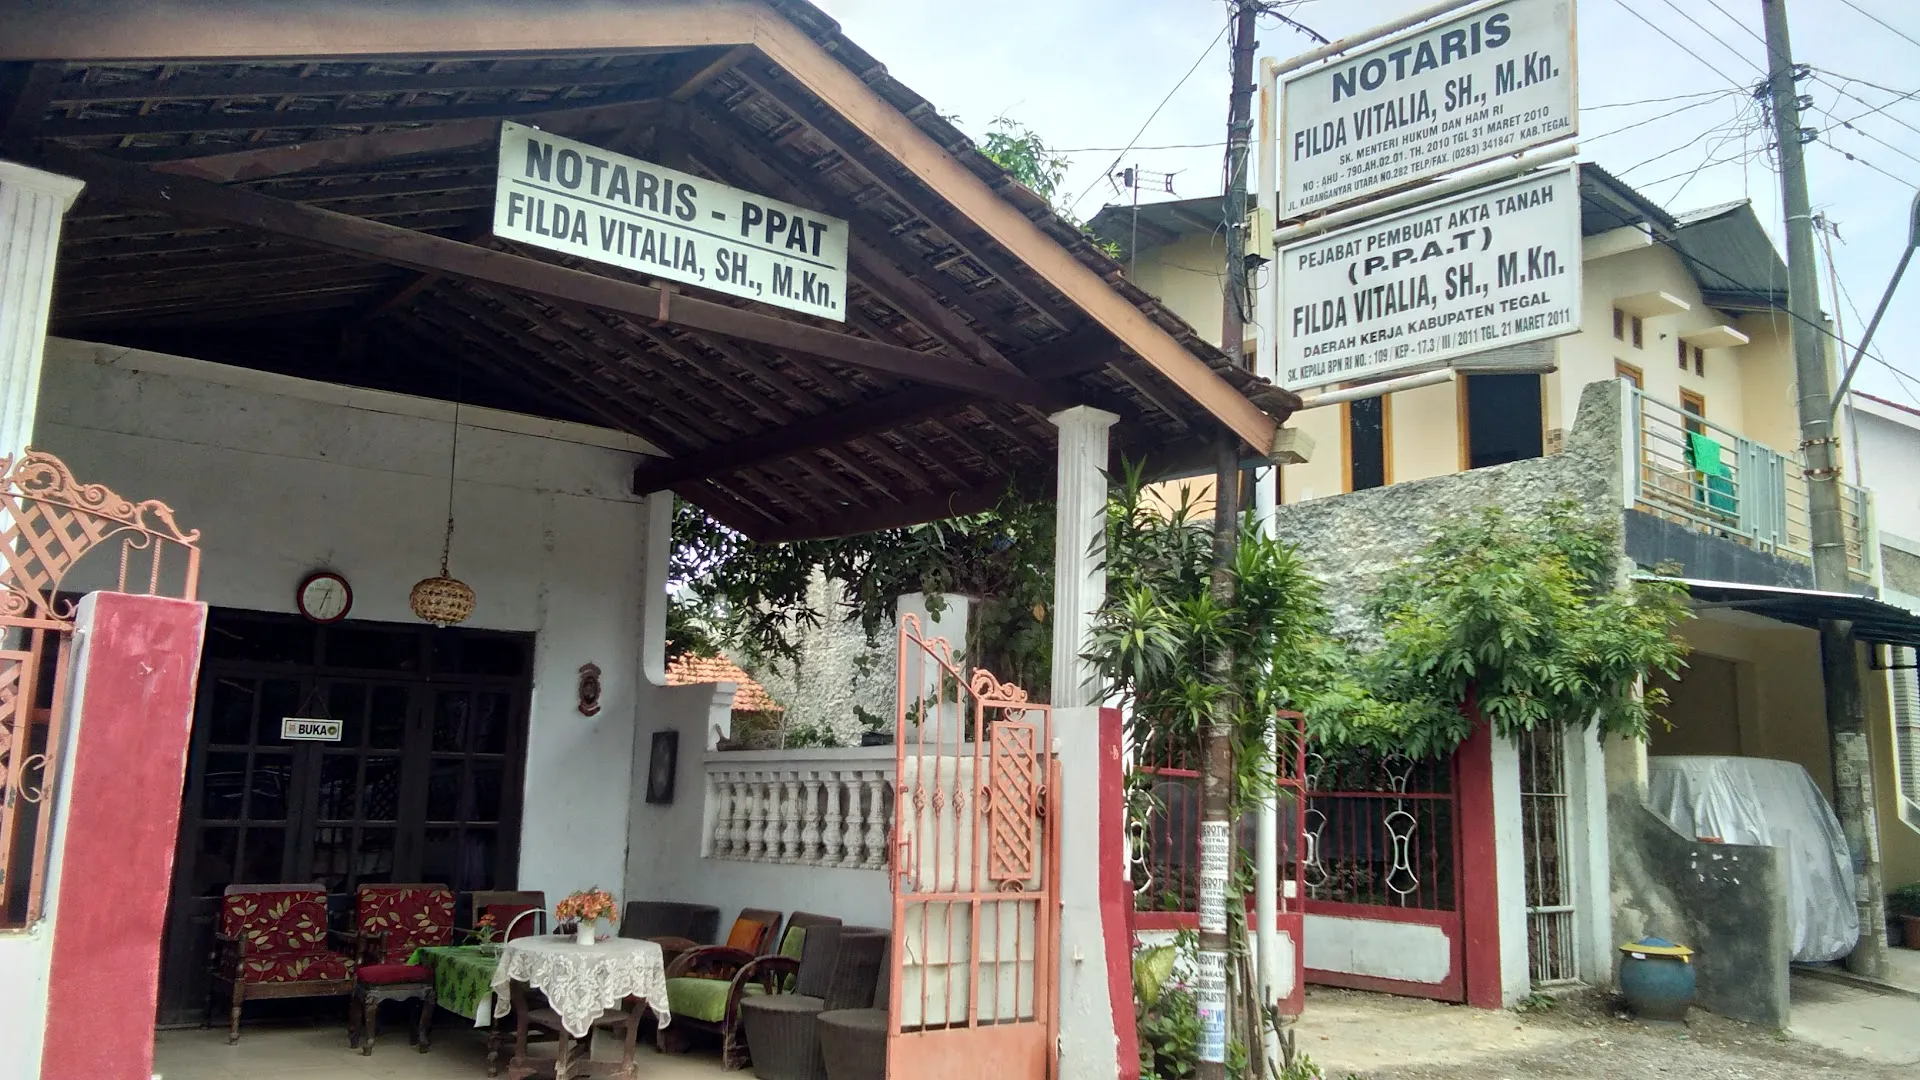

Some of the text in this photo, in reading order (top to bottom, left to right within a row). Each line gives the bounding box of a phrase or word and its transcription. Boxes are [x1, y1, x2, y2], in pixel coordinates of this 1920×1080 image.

[1332, 12, 1511, 103] NOTARIS
[1294, 51, 1559, 162] FILDA VITALIA, SH., M.Kn.
[1322, 172, 1338, 187] AHU
[1410, 146, 1424, 158] TH.
[1427, 136, 1449, 150] 2010
[1453, 132, 1468, 144] TGL
[1472, 127, 1482, 138] 31
[1487, 116, 1520, 134] MARET
[1524, 106, 1549, 122] 2010
[1340, 104, 1503, 165] SK. MENTERI HUKUM DAN HAM RI
[525, 139, 697, 222] NOTARIS
[741, 201, 827, 257] PPAT
[1288, 201, 1297, 211] JL.
[1300, 183, 1352, 207] KARANGANYAR
[1354, 175, 1378, 190] UTARA
[1411, 155, 1449, 173] TELP/FAX.
[1452, 146, 1480, 162] (0283)
[1482, 133, 1514, 150] 341847
[1520, 126, 1540, 140] KAB.
[1543, 117, 1570, 133] TEGAL
[507, 192, 836, 309] FILDA VITALIA, SH., M.Kn.
[1299, 184, 1553, 271] PEJABAT PEMBUAT AKTA TANAH
[1293, 245, 1564, 338] FILDA VITALIA, SH., M.Kn.
[1304, 292, 1550, 358] DAERAH KERJA KABUPATEN TEGAL
[1288, 369, 1298, 382] SK.
[1300, 362, 1325, 379] KEPALA
[1328, 357, 1342, 373] BPN
[1345, 356, 1352, 370] RI
[1374, 349, 1387, 363] 109
[1395, 344, 1409, 359] KEP
[1418, 338, 1434, 355] 17.3
[1458, 328, 1478, 346] 2011
[1482, 325, 1499, 340] TGL.
[1502, 321, 1511, 336] 21
[1515, 314, 1545, 334] MARET
[1548, 308, 1570, 326] 2011
[298, 724, 326, 735] BUKA
